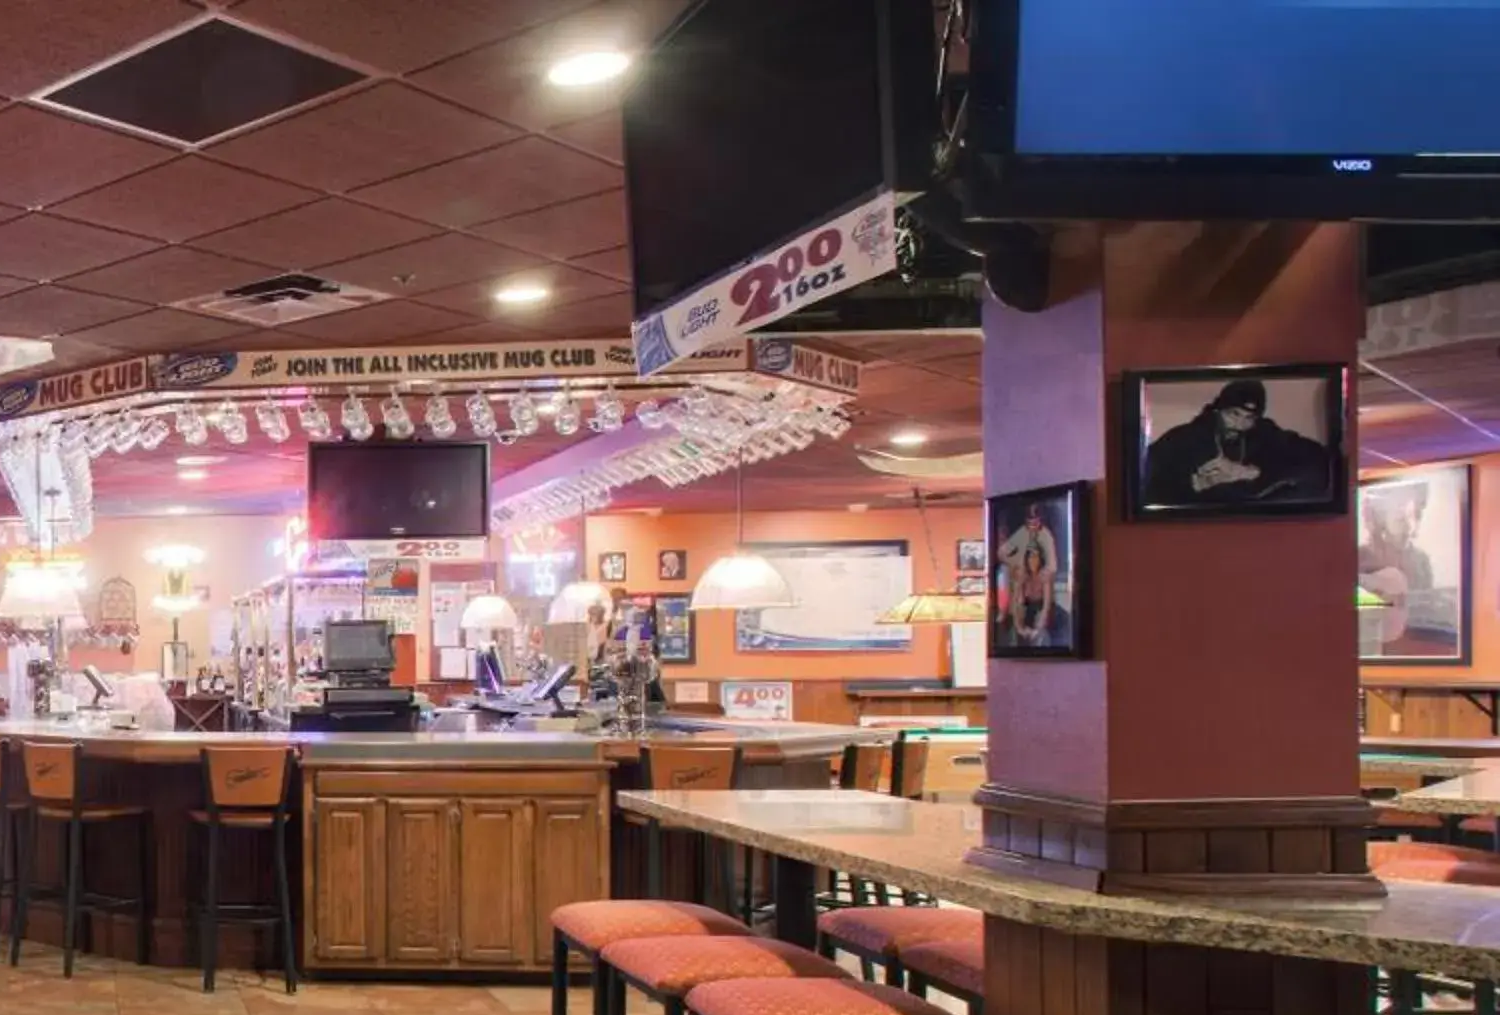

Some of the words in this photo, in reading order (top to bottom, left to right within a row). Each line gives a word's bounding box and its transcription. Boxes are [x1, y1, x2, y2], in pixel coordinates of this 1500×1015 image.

[1333, 159, 1372, 171] VIZIO
[730, 228, 842, 326] 200
[679, 309, 721, 340] LIGHT
[688, 297, 718, 322] BUD
[286, 358, 327, 378] JOIN
[333, 356, 364, 376] THE
[369, 354, 402, 374] ALL
[407, 350, 499, 373] INCLUSIVE
[503, 349, 546, 371] MUG
[550, 348, 596, 368] CLUB
[793, 348, 824, 382] MUG
[827, 358, 859, 389] CLUB
[39, 375, 84, 407] MUG
[89, 360, 143, 396] CLUB
